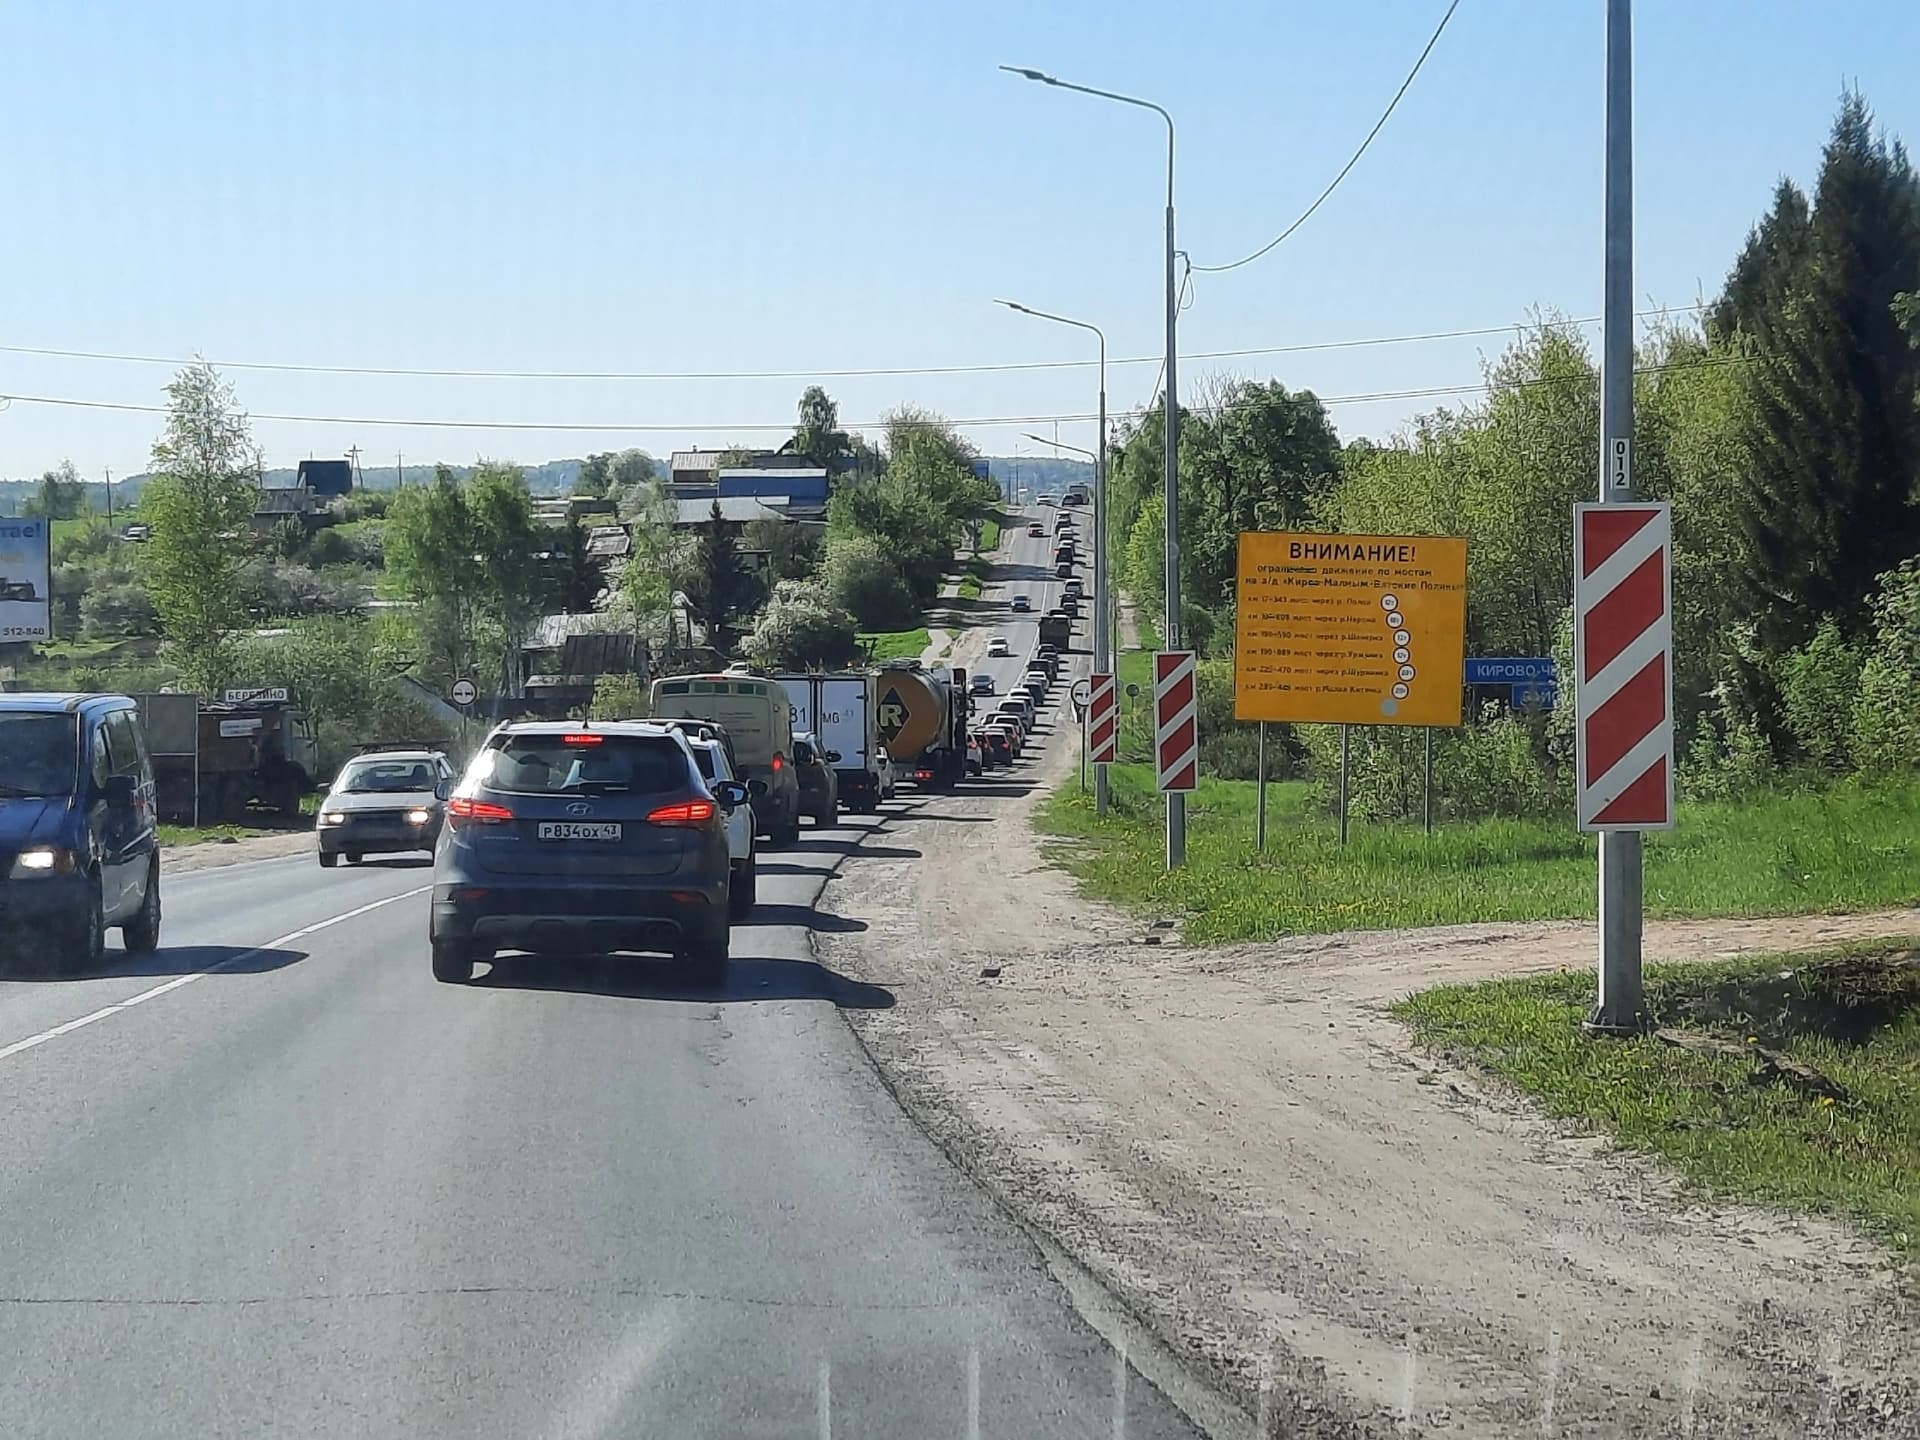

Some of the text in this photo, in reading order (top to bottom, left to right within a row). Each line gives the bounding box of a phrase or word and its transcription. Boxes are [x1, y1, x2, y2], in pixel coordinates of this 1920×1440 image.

[1615, 441, 1626, 487] 012
[1289, 542, 1416, 563] ВНИМАНИЕ!
[1245, 577, 1258, 585] на
[1261, 575, 1279, 586] а/д
[1377, 568, 1390, 576] по
[1394, 568, 1432, 577] мостам
[879, 704, 902, 727] R
[603, 825, 617, 836] 43
